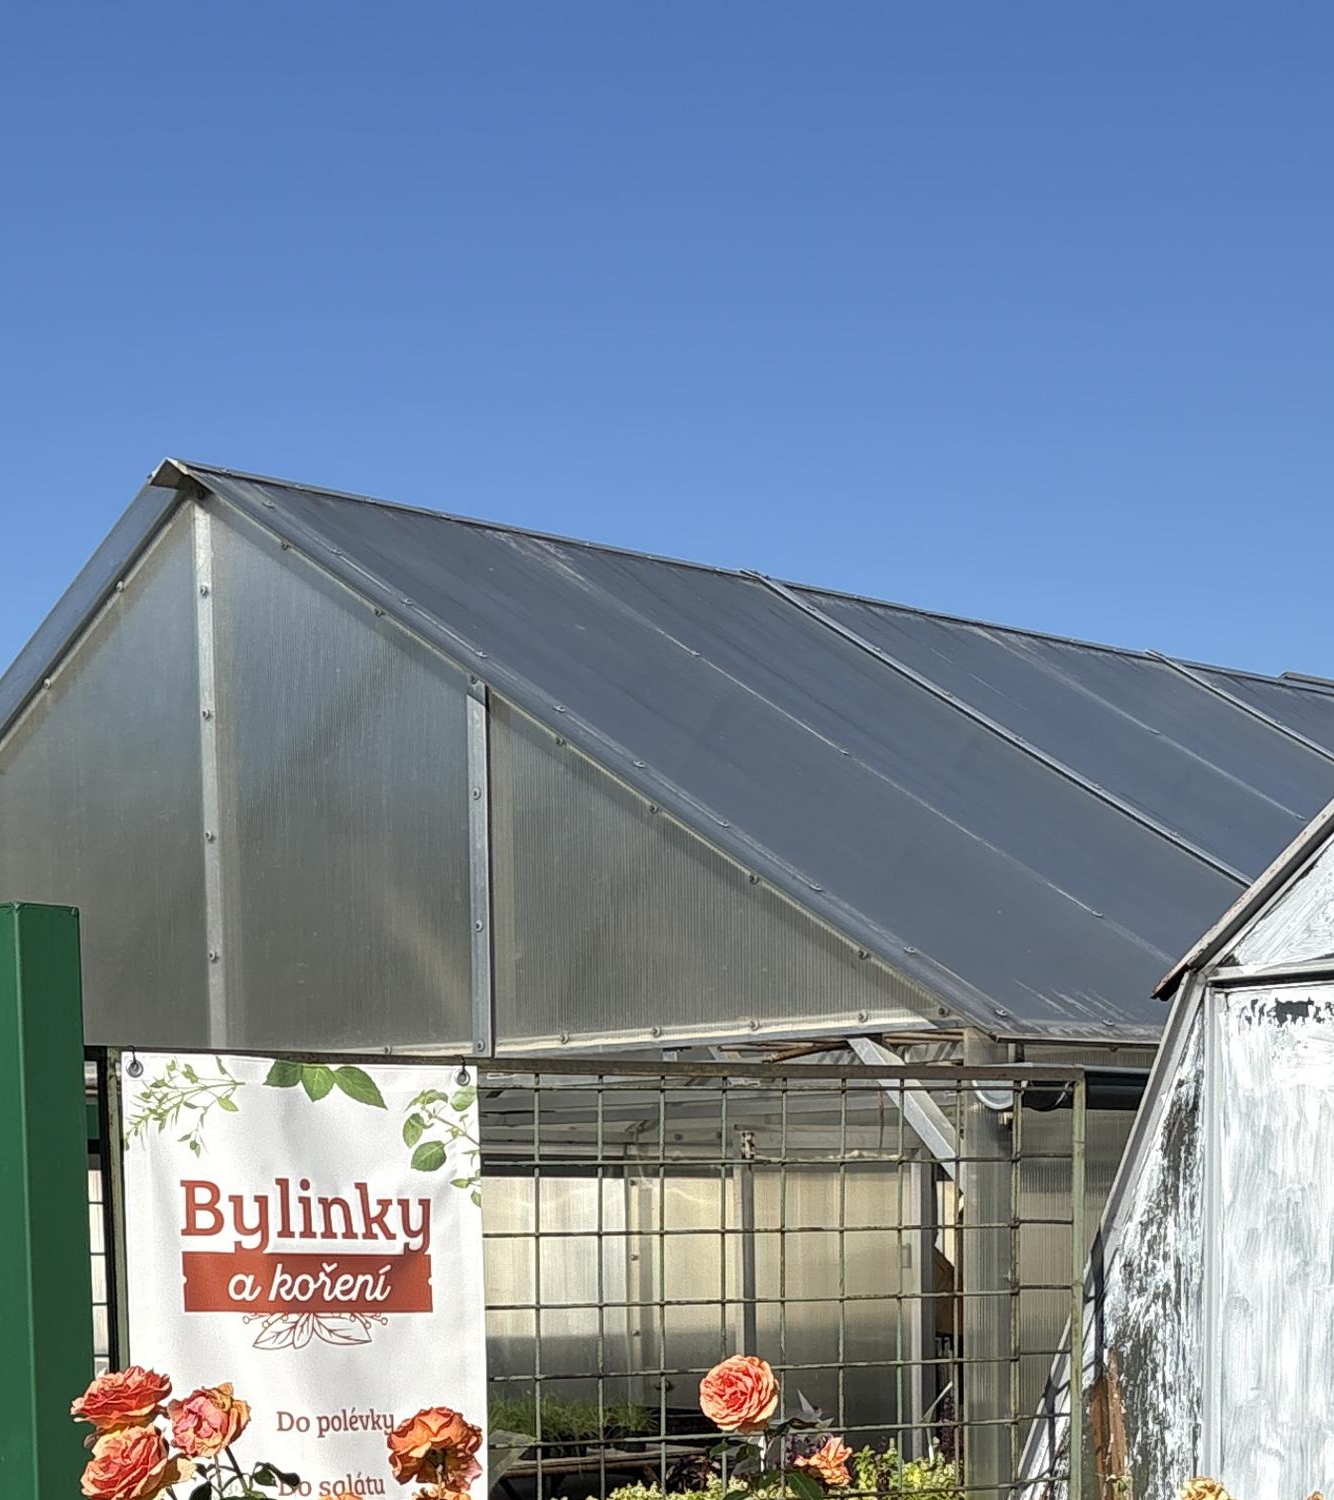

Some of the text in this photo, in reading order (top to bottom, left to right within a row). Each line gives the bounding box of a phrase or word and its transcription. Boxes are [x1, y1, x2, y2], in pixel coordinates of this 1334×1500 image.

[180, 1178, 432, 1254] Bylinky
[228, 1262, 392, 1301] a koření
[276, 1407, 395, 1438] Do polévky
